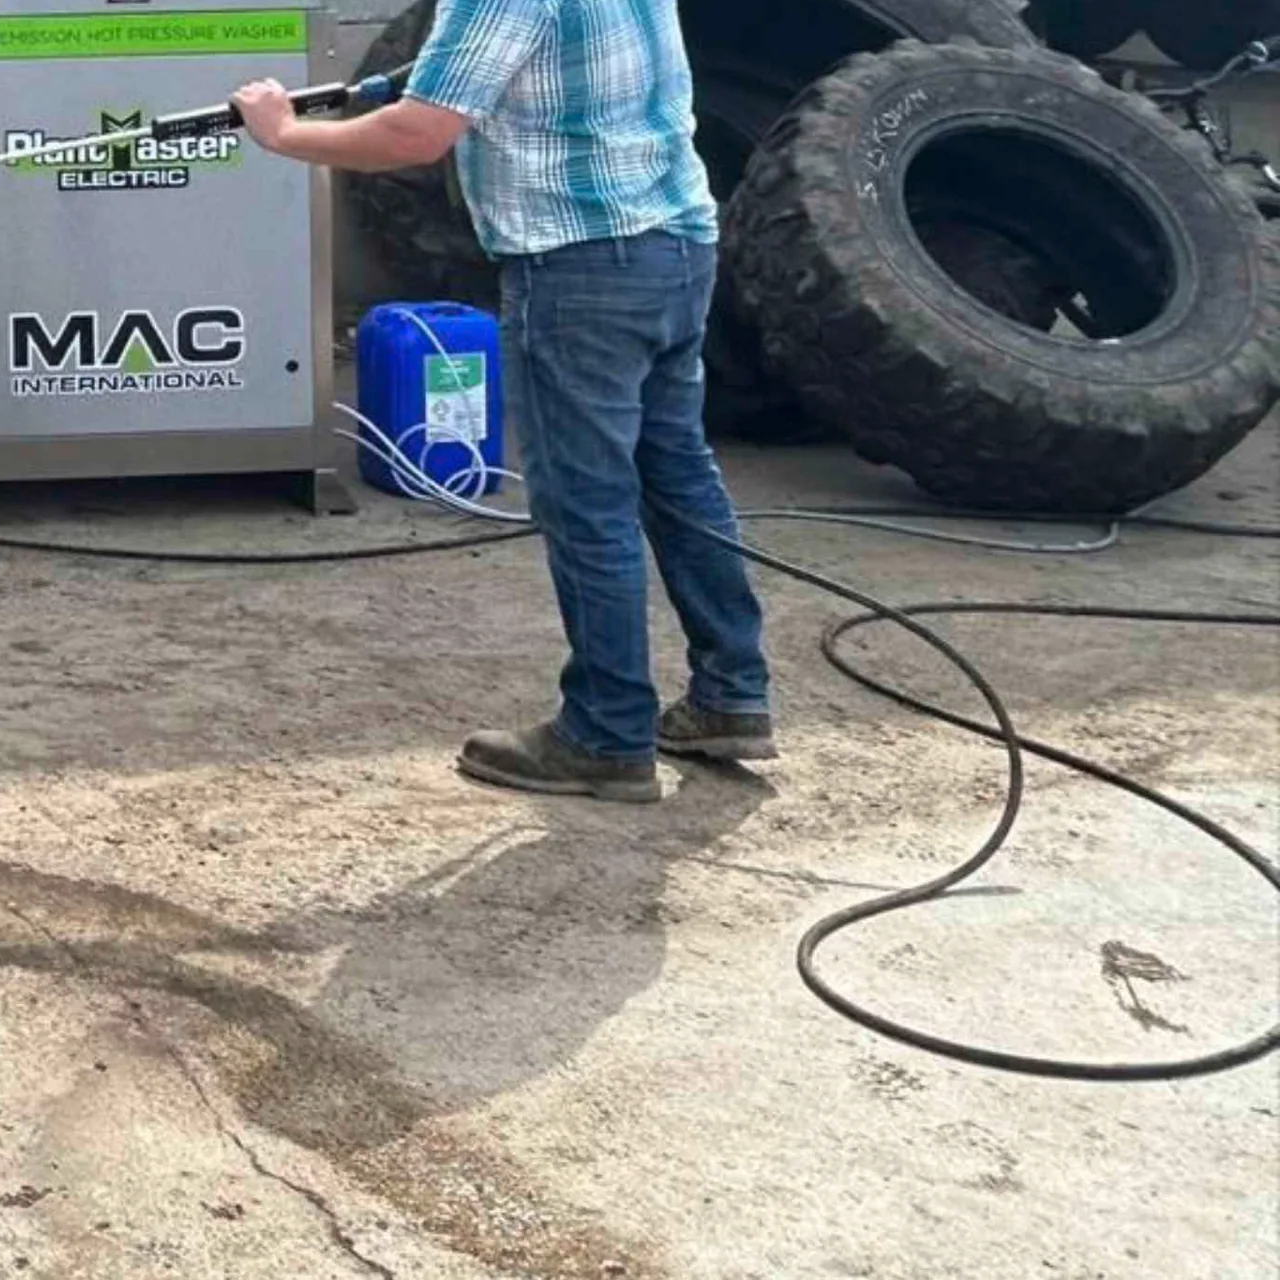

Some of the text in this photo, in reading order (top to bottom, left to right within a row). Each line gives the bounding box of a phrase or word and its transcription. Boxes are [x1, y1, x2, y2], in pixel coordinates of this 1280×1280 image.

[90, 26, 122, 42] HOT
[128, 24, 214, 42] PRESSURE
[222, 23, 298, 41] WASHER
[60, 169, 187, 188] ELECTRIC
[10, 305, 244, 371] MAC
[12, 370, 243, 395] INTERNATIONAL
